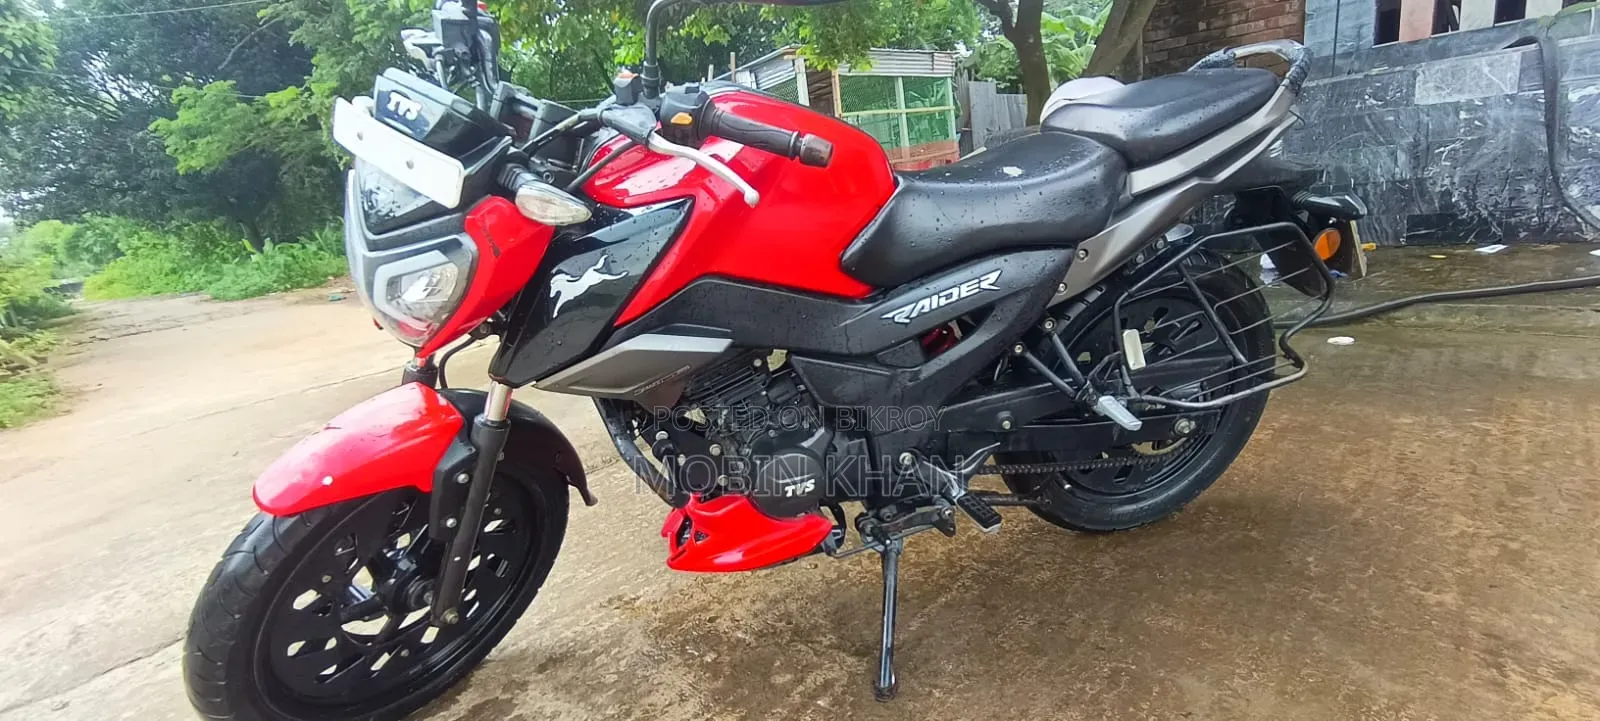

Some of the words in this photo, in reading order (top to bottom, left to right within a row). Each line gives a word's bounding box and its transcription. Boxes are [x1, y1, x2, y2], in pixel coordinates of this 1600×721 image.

[387, 91, 422, 121] TVS
[880, 270, 1002, 324] RAIDER
[784, 478, 815, 497] TVS
